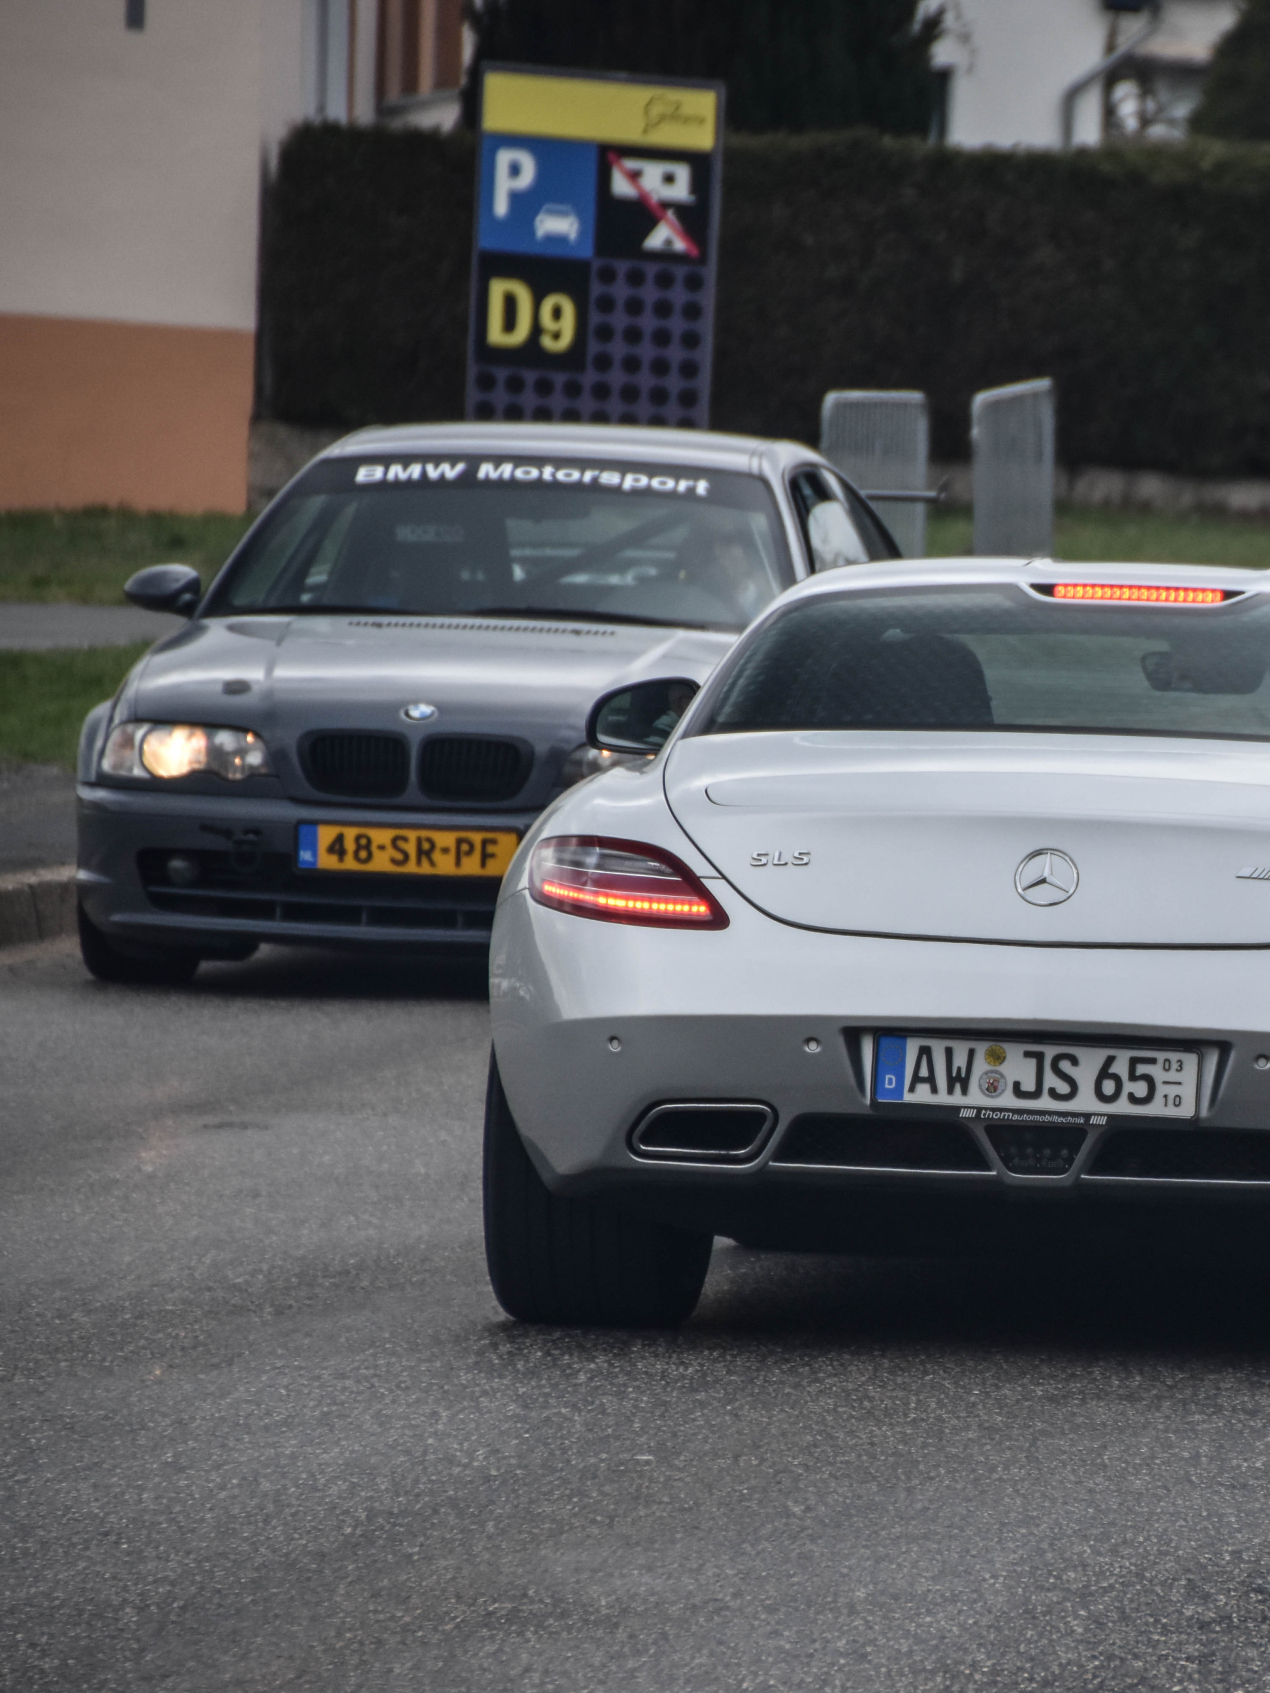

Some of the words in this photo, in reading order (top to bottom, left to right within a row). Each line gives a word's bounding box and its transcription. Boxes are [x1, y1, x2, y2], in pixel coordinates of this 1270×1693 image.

[493, 147, 537, 219] P
[486, 277, 577, 354] D9
[355, 462, 467, 484] BMW
[477, 461, 710, 497] Motorsport
[325, 832, 499, 869] 48-SR-PF
[750, 850, 811, 867] SLS
[884, 1074, 896, 1089] D
[907, 1044, 975, 1097] AW
[1012, 1050, 1080, 1102] JS
[1094, 1055, 1157, 1106] 65
[1162, 1058, 1184, 1073] 03
[1162, 1094, 1182, 1107] 10
